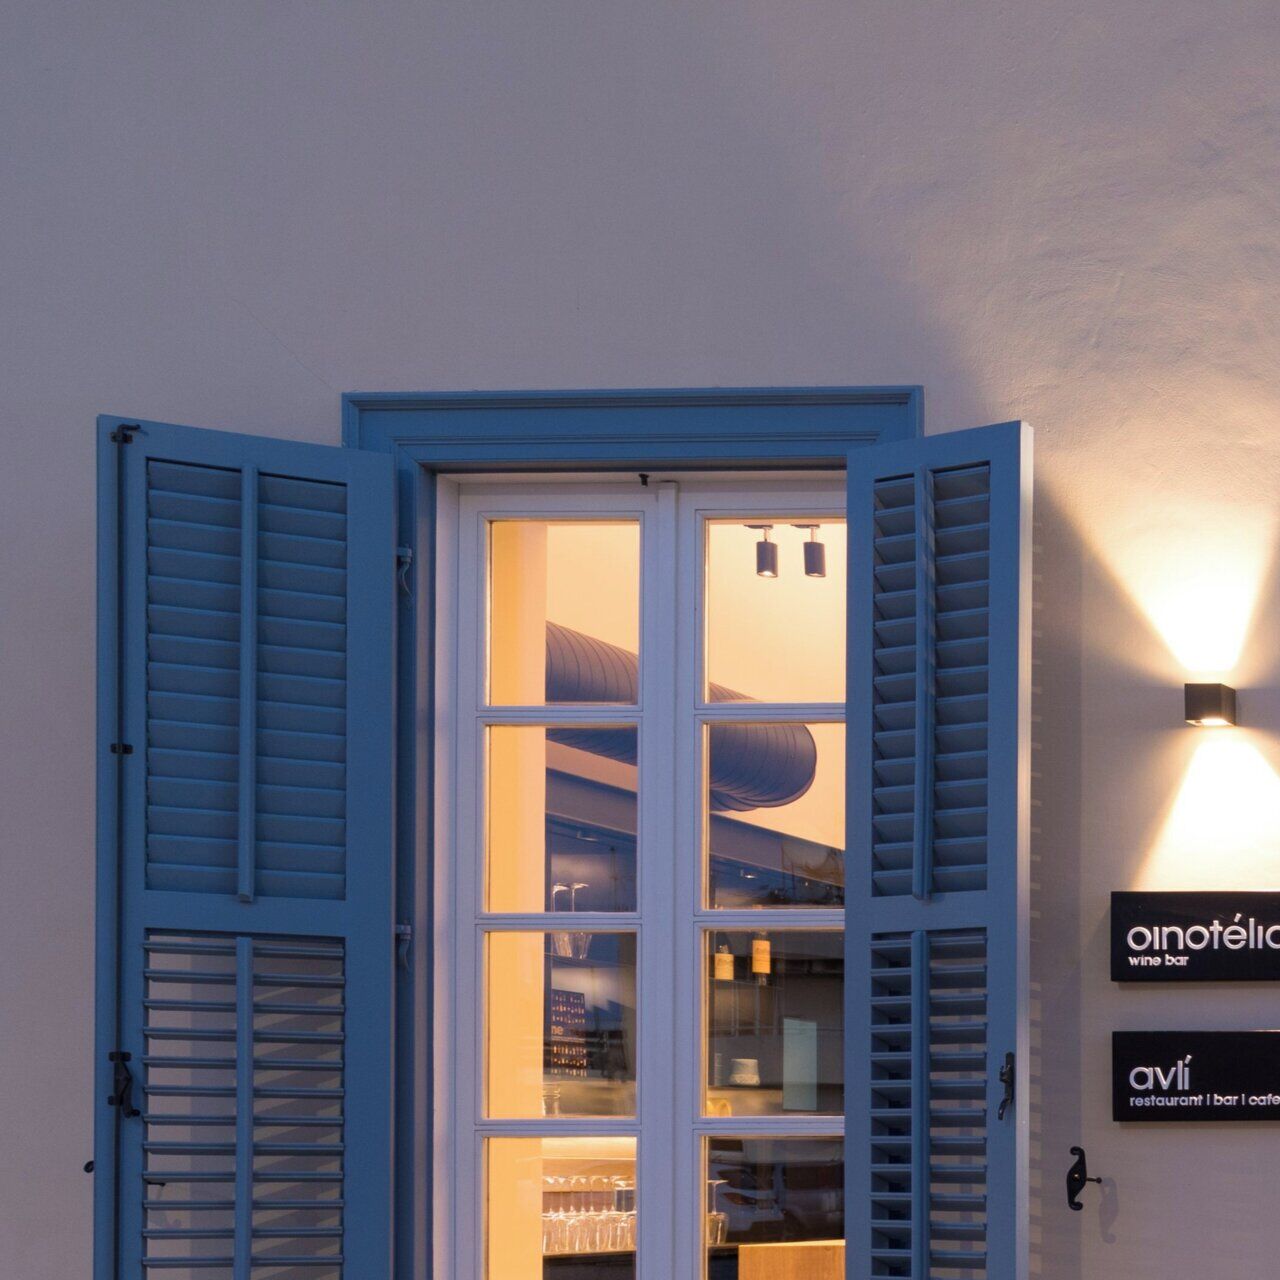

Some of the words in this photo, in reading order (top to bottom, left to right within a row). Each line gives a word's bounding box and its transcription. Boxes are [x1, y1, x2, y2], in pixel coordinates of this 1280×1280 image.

[1127, 954, 1162, 967] wine
[1164, 953, 1190, 966] bar
[1129, 1054, 1193, 1091] avlí
[1129, 1094, 1204, 1107] restaurant
[1213, 1093, 1239, 1106] bar
